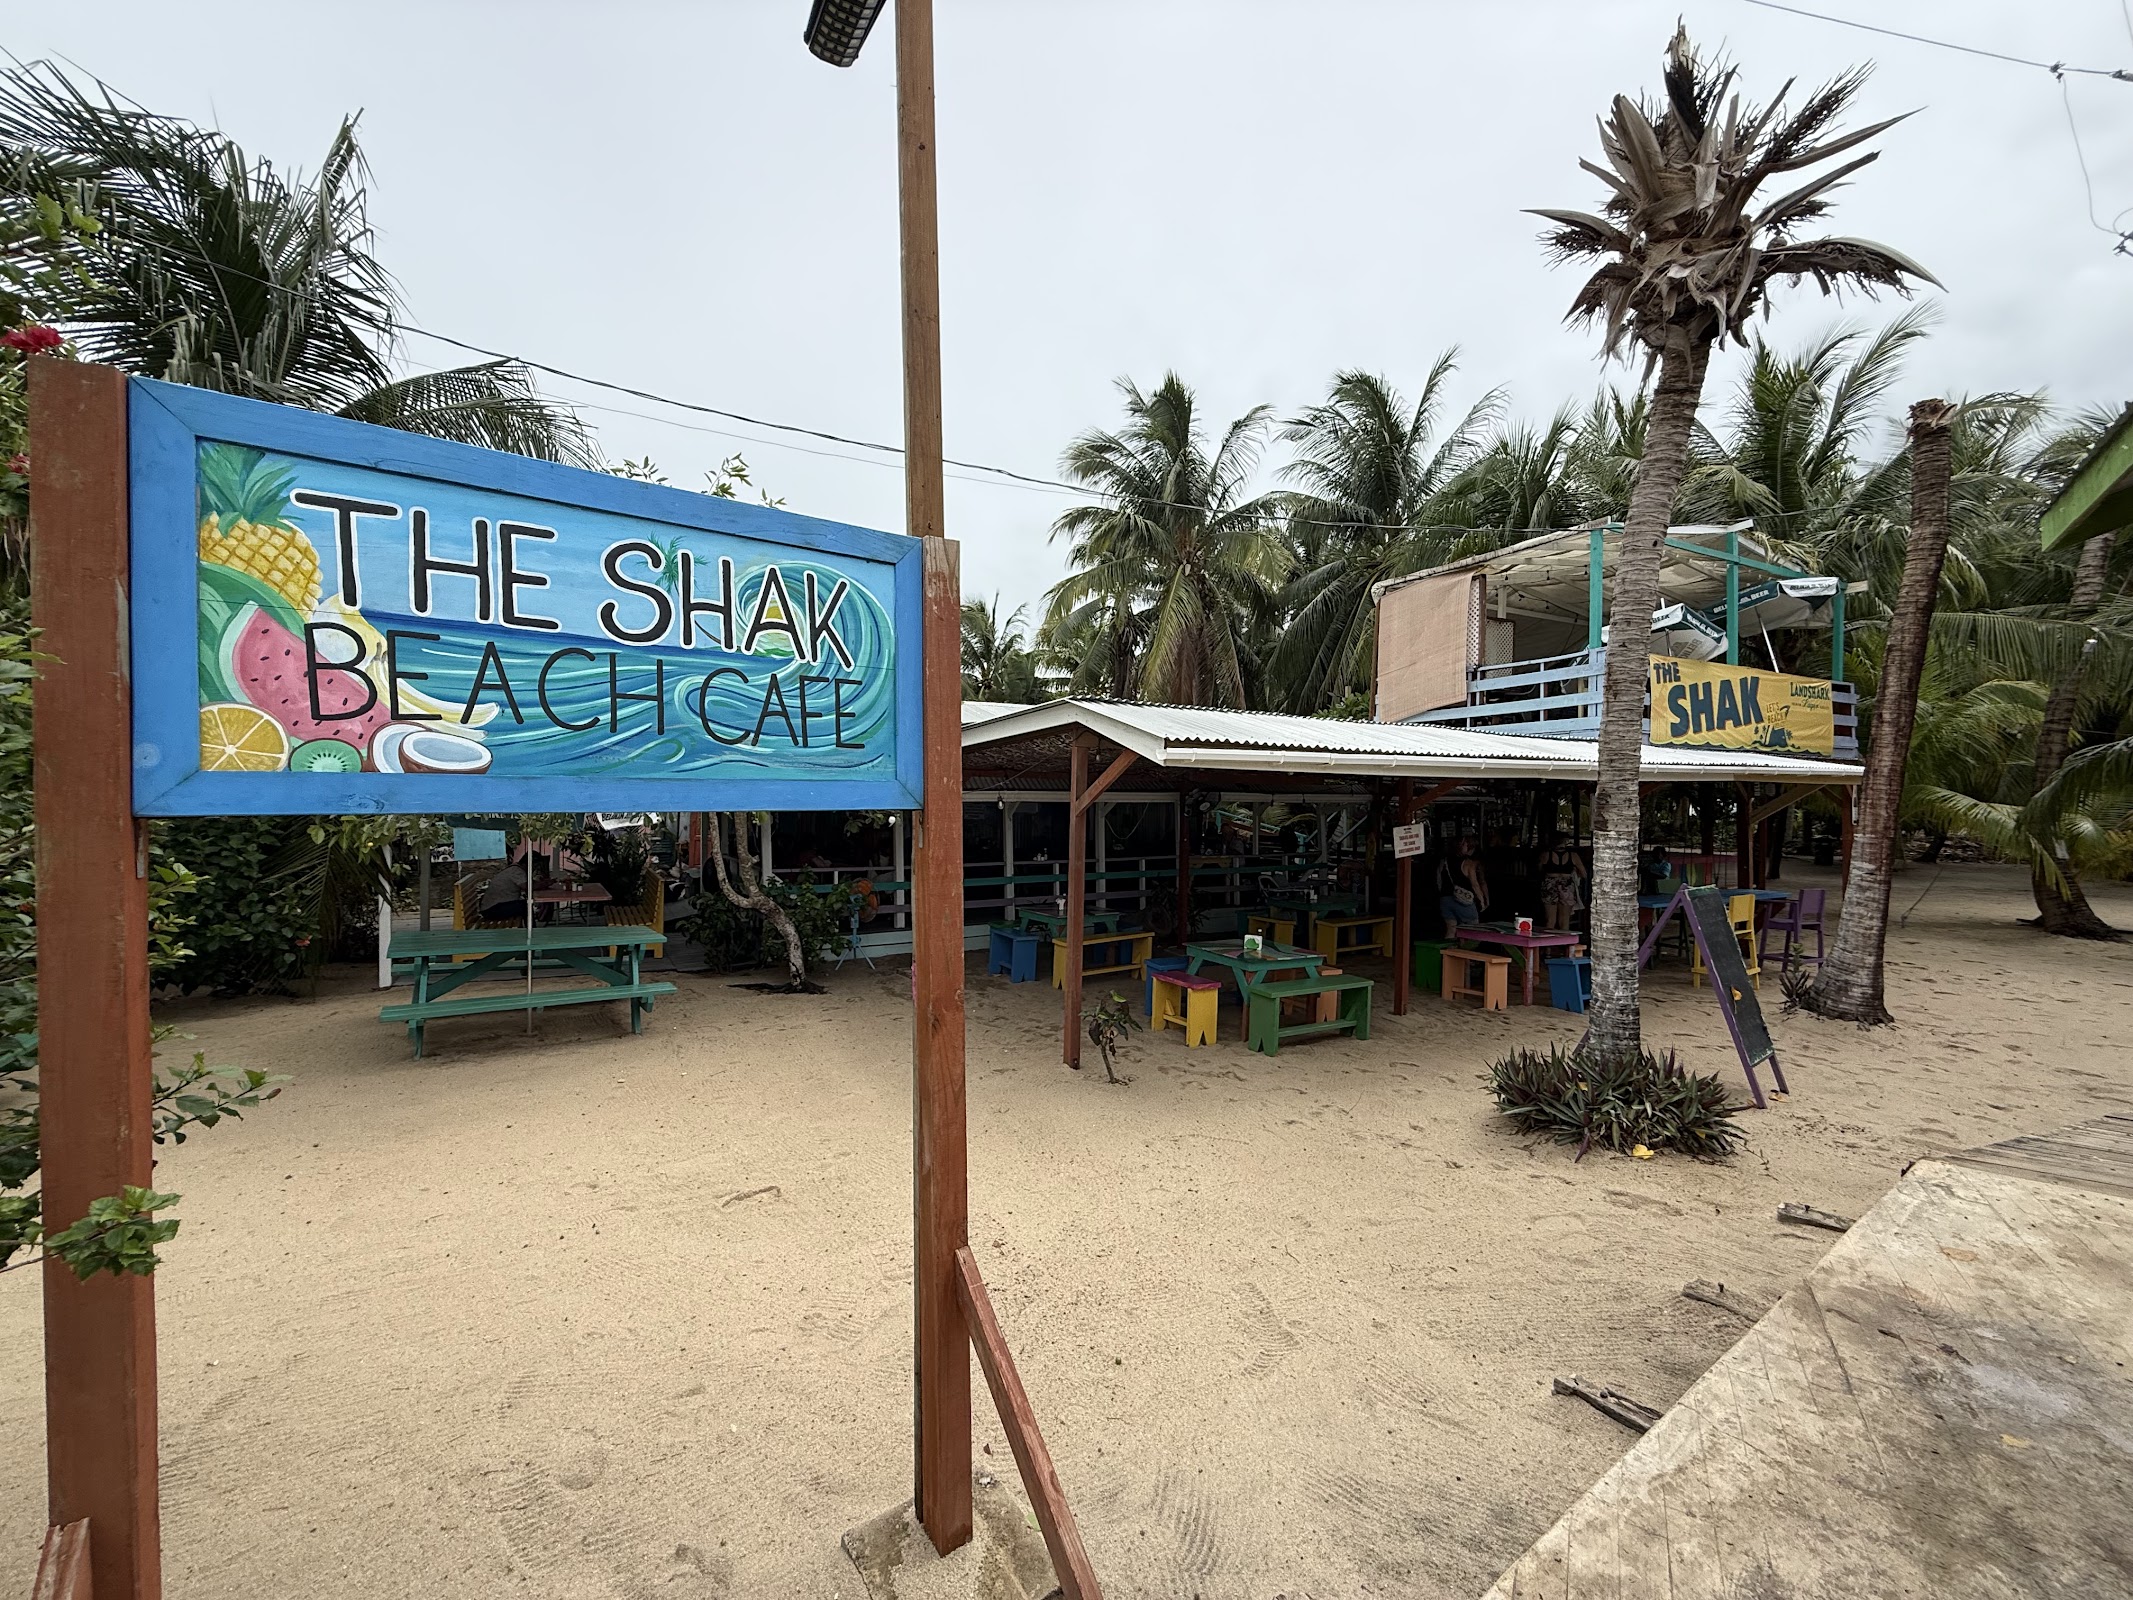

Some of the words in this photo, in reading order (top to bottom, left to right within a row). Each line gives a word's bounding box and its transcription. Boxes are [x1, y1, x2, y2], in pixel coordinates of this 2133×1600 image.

[291, 490, 561, 631] THE
[598, 539, 853, 671] SHAK
[1750, 590, 1770, 600] BEER
[304, 621, 665, 735] BEACH
[700, 667, 866, 749] CAFE
[1653, 662, 1681, 684] THE
[1667, 676, 1764, 738] SHAK
